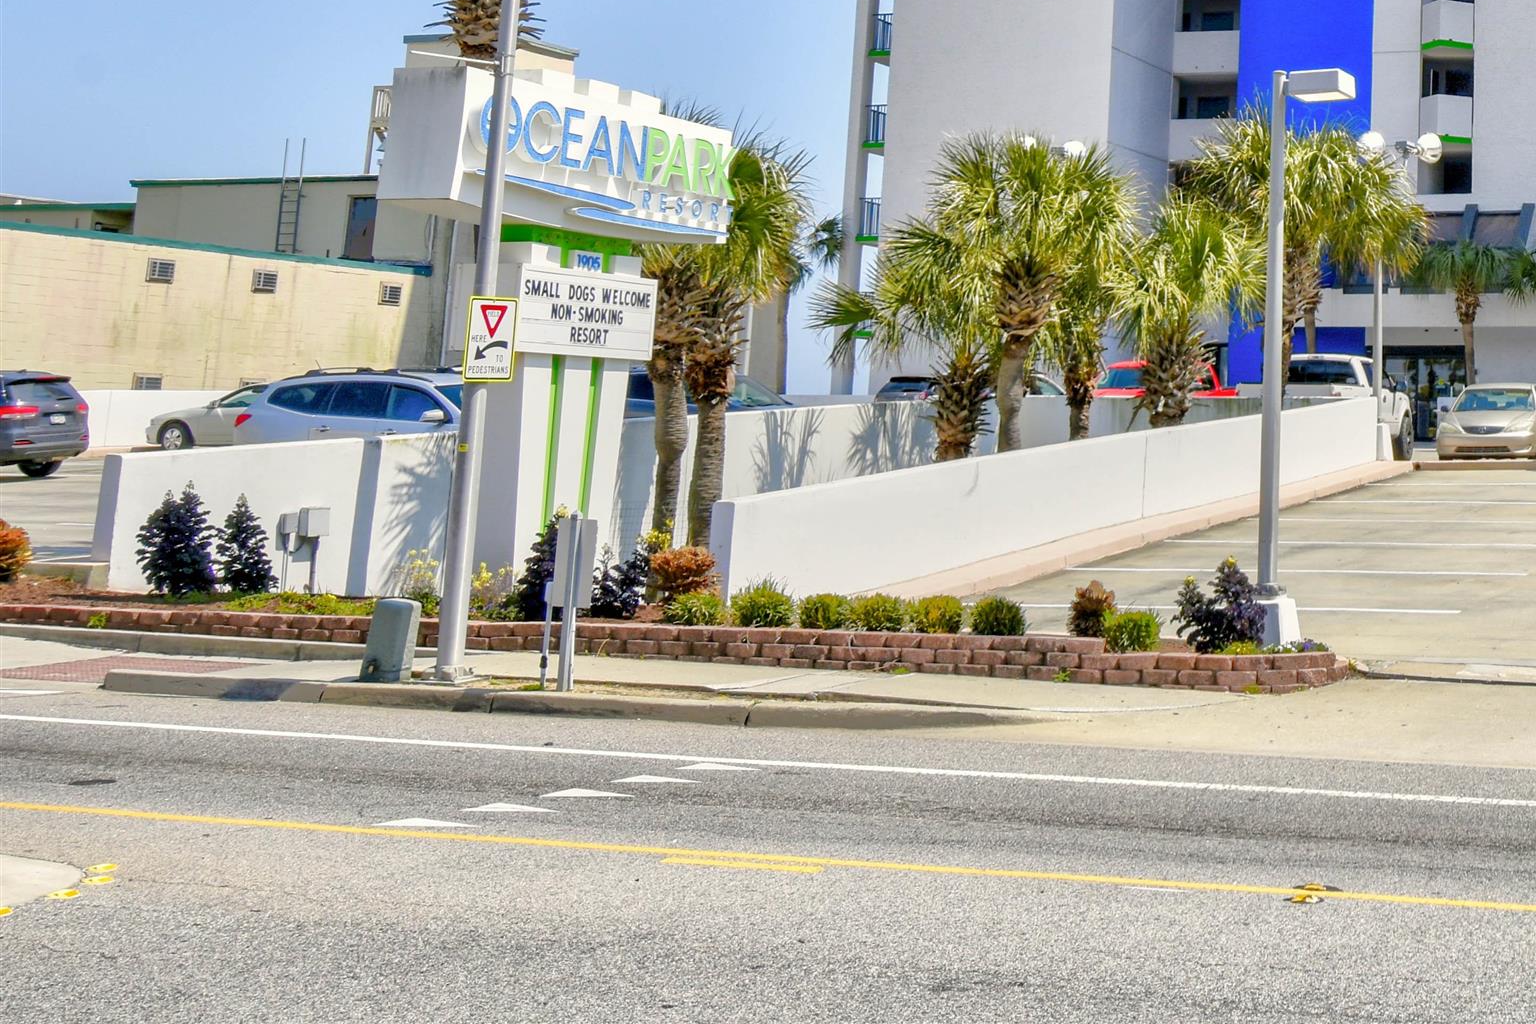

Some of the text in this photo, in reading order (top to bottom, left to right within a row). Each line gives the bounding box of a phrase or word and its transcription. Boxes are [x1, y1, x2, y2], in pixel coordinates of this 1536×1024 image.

[577, 254, 600, 271] 1905
[524, 279, 651, 308] SMALL DOGS WELCOME
[471, 335, 487, 343] HERE
[570, 326, 609, 344] RESORT
[468, 365, 508, 374] PEDESTRIANS
